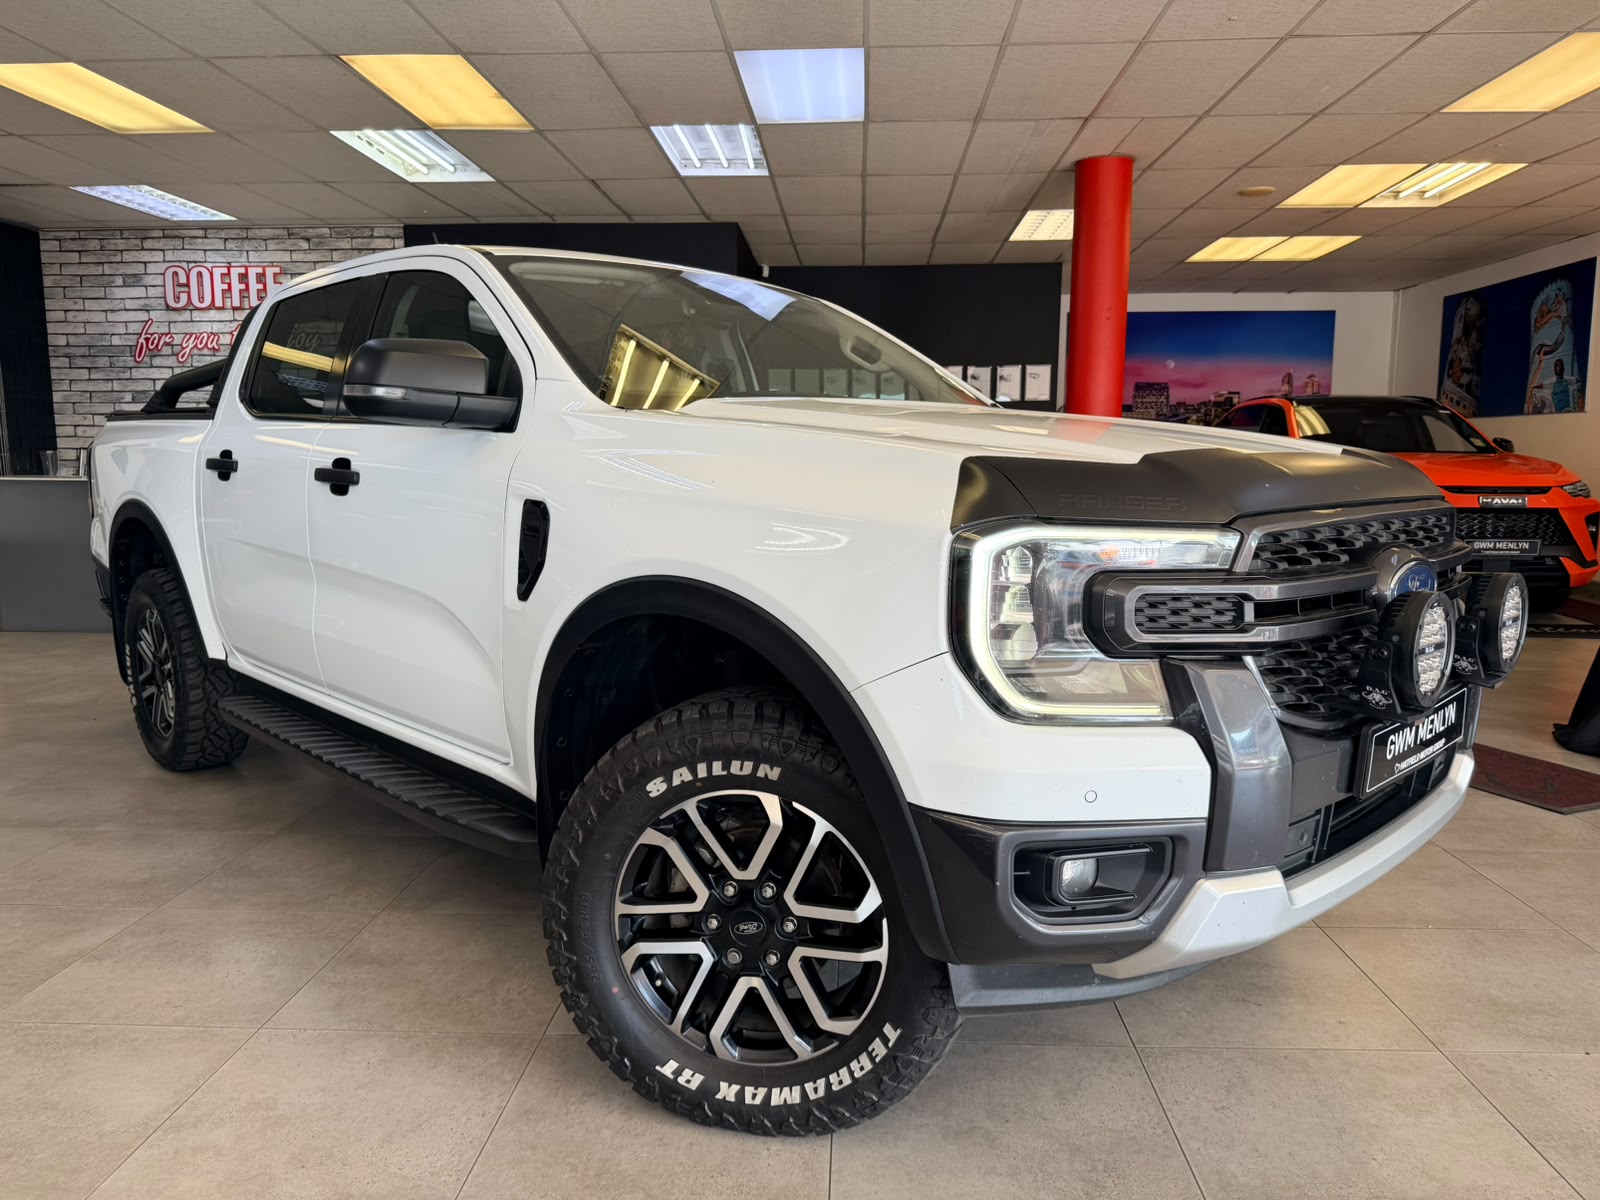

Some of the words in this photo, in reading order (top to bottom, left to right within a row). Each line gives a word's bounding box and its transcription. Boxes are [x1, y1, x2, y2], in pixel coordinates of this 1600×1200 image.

[134, 318, 174, 363] for
[177, 331, 220, 363] you
[1473, 541, 1494, 550] GWM
[1496, 541, 1529, 550] MENLYN
[1386, 726, 1416, 760] GWM
[1416, 701, 1456, 745] MENLYN
[645, 760, 782, 798] SAILUN
[655, 1058, 706, 1091] RT
[715, 1021, 902, 1106] TERRAMAX
